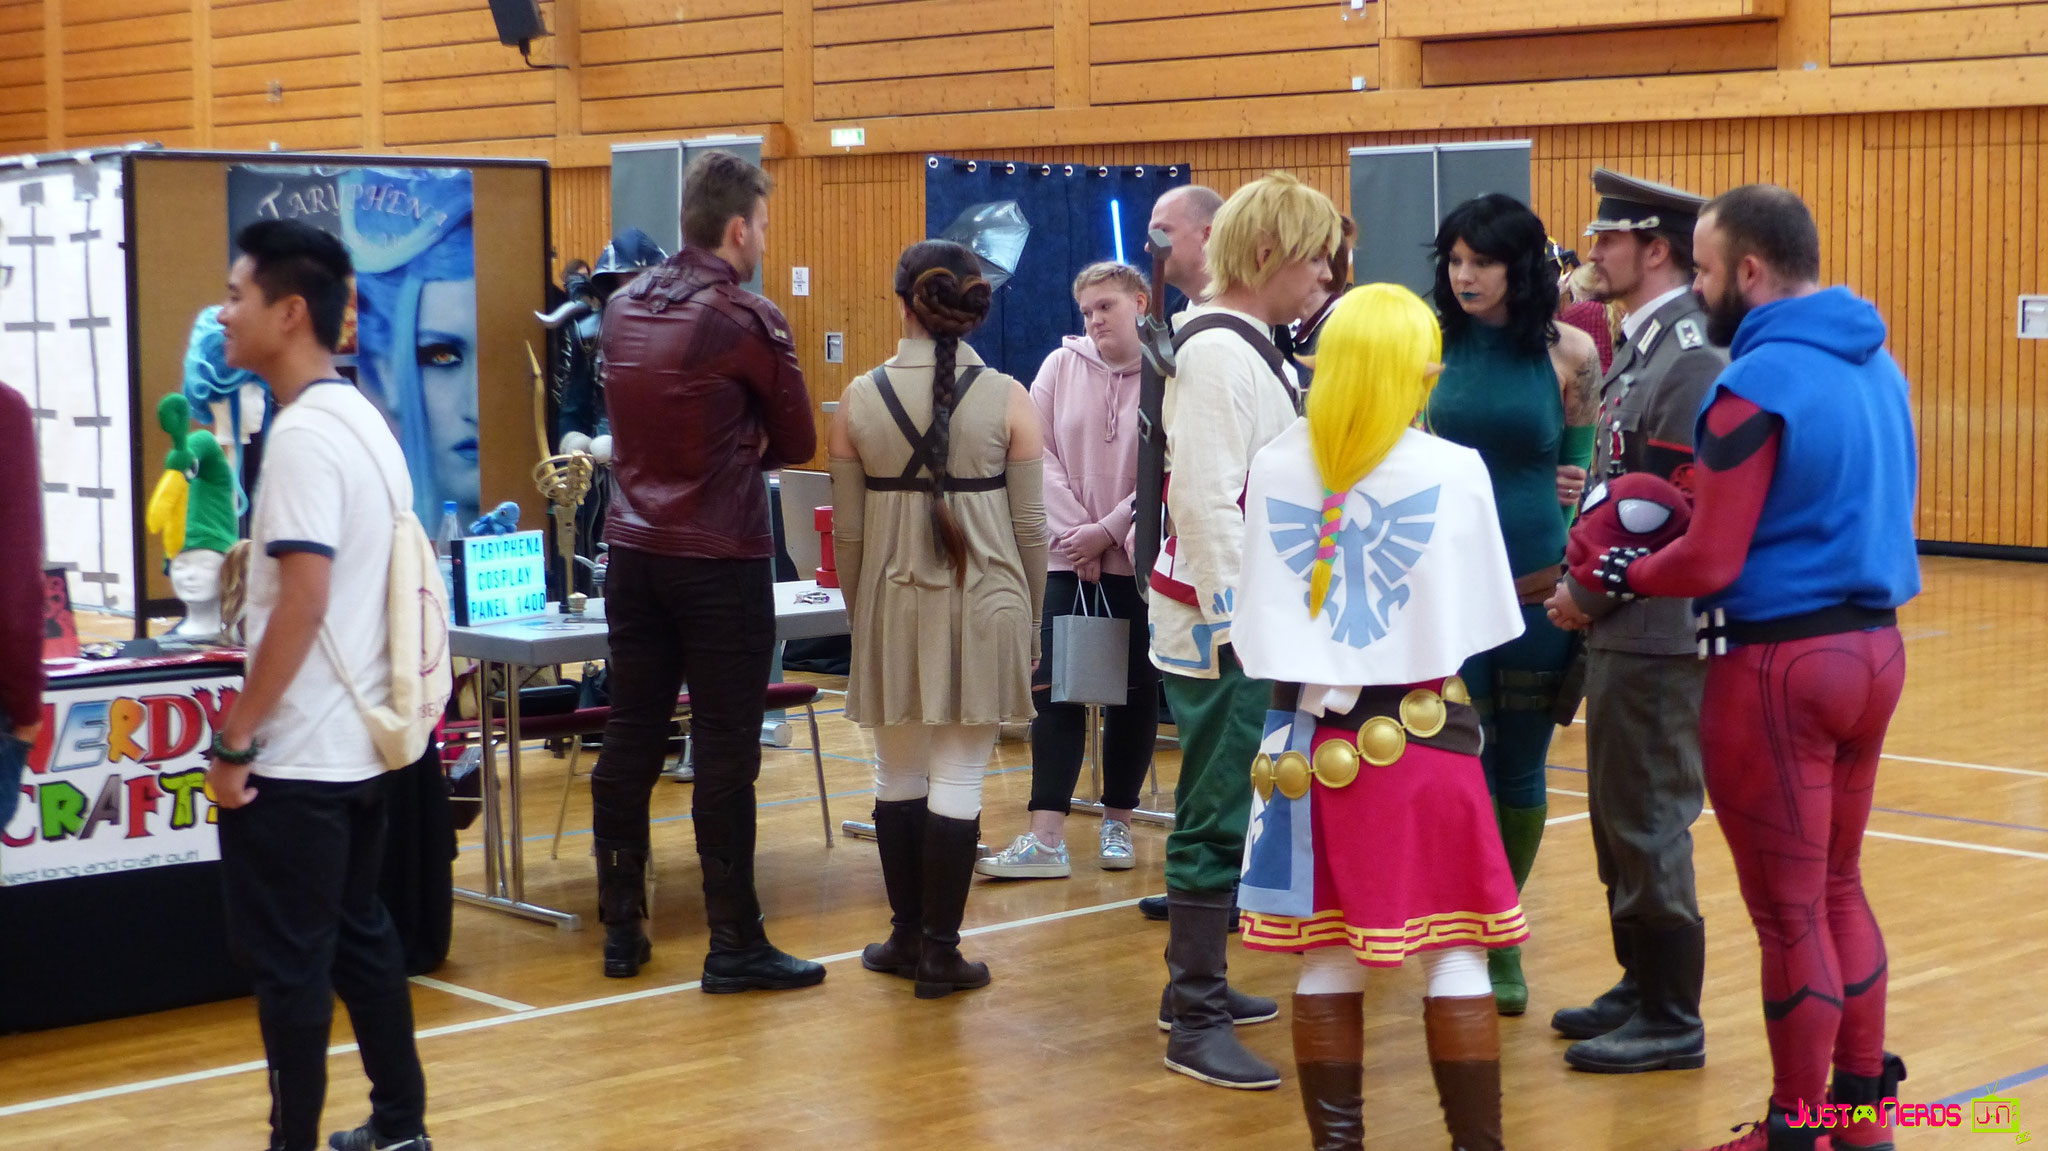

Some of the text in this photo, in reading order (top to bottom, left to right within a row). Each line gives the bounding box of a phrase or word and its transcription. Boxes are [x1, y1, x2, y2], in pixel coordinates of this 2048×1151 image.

[472, 537, 540, 562] TARYPHENA
[479, 567, 531, 590] COSPLAY
[472, 592, 545, 620] PANEL 1400
[85, 858, 119, 873] and
[122, 853, 162, 868] craft
